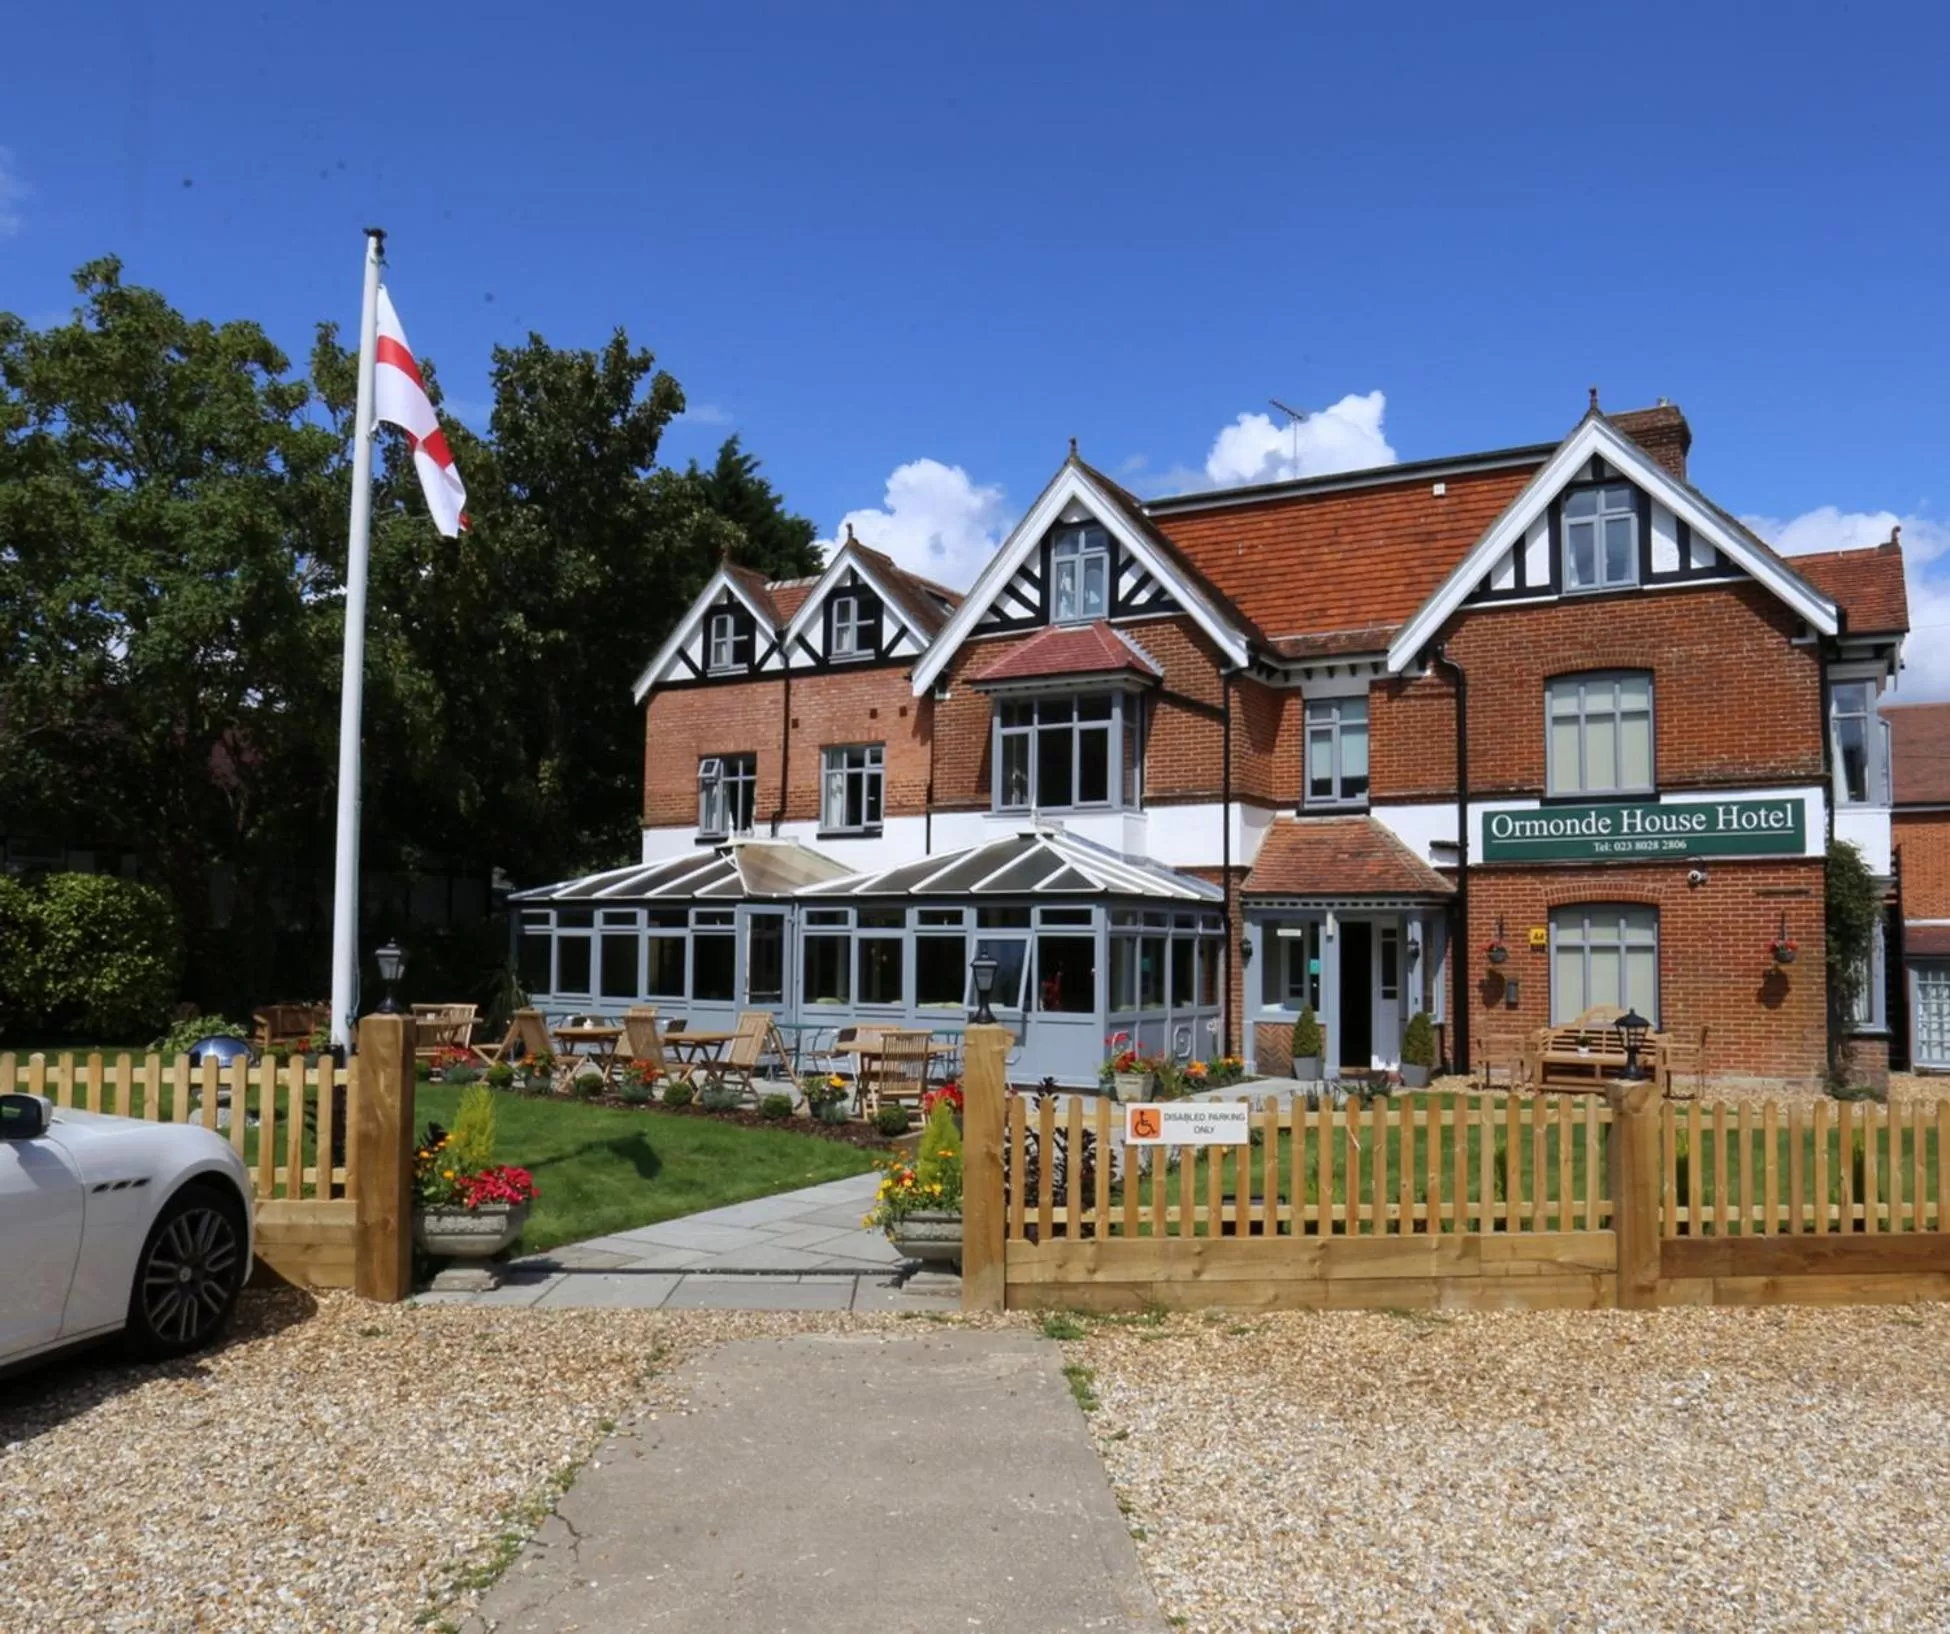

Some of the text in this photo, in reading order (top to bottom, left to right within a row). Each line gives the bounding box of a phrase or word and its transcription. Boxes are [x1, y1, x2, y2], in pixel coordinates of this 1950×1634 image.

[1491, 802, 1795, 838] Ormonde House Hotel
[1593, 842, 1612, 852] Tel:
[1613, 841, 1632, 851] 023
[1163, 1112, 1245, 1121] DISABLED PARKING
[1194, 1126, 1214, 1134] ONLY
